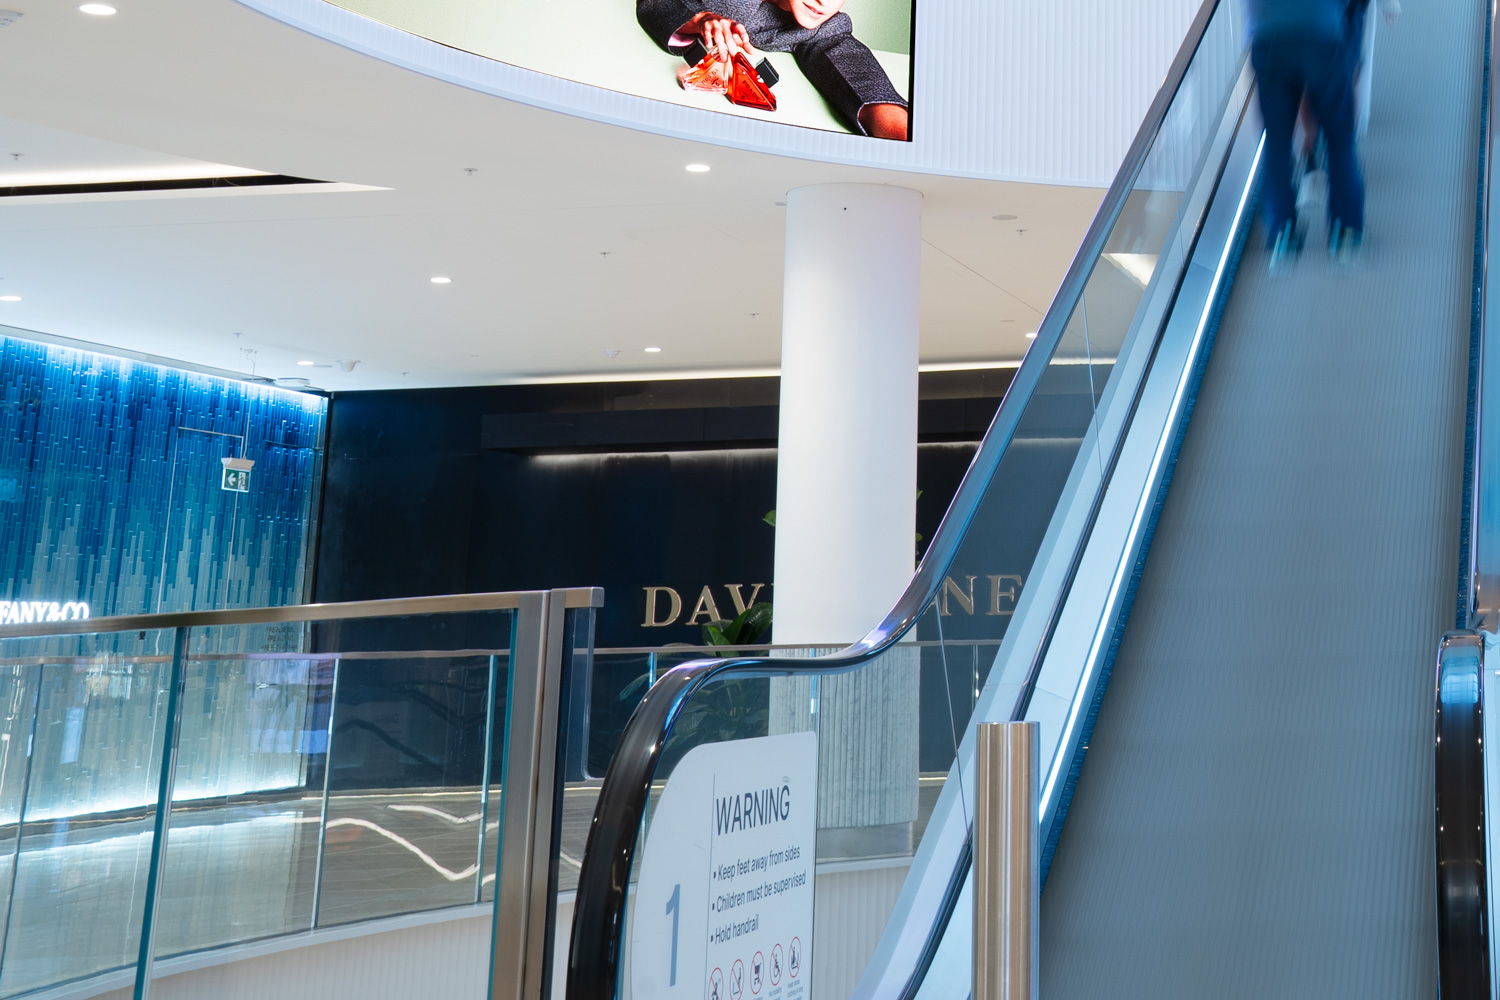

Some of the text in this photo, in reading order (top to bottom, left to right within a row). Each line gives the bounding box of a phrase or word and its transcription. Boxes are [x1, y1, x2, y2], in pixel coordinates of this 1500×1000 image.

[0, 601, 89, 624] FANY&CO
[641, 583, 770, 627] DAV
[716, 785, 790, 836] WARNING
[718, 845, 800, 882] Keep feet away from sides
[716, 869, 806, 912] Children must be supervised
[666, 884, 680, 987] 1
[715, 914, 760, 945] Hold handrail
